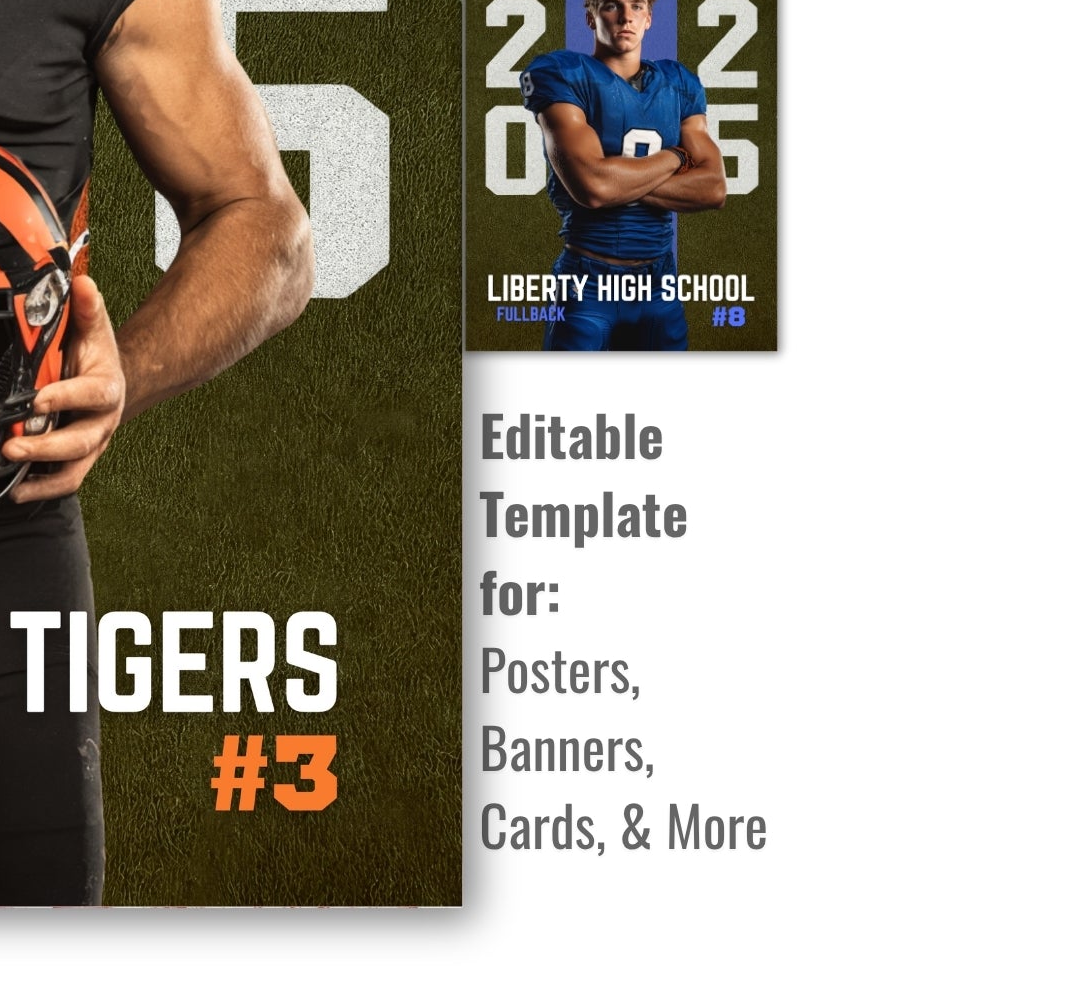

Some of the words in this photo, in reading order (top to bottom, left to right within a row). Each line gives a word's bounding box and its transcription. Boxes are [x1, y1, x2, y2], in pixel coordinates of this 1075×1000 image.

[487, 274, 589, 302] LIBERTY
[598, 274, 652, 302] HIGH
[661, 274, 755, 302] SCHOOL
[497, 306, 565, 322] FULLBACK
[712, 307, 746, 327] #8
[9, 610, 338, 714] TIGERS
[211, 735, 338, 812] #3
